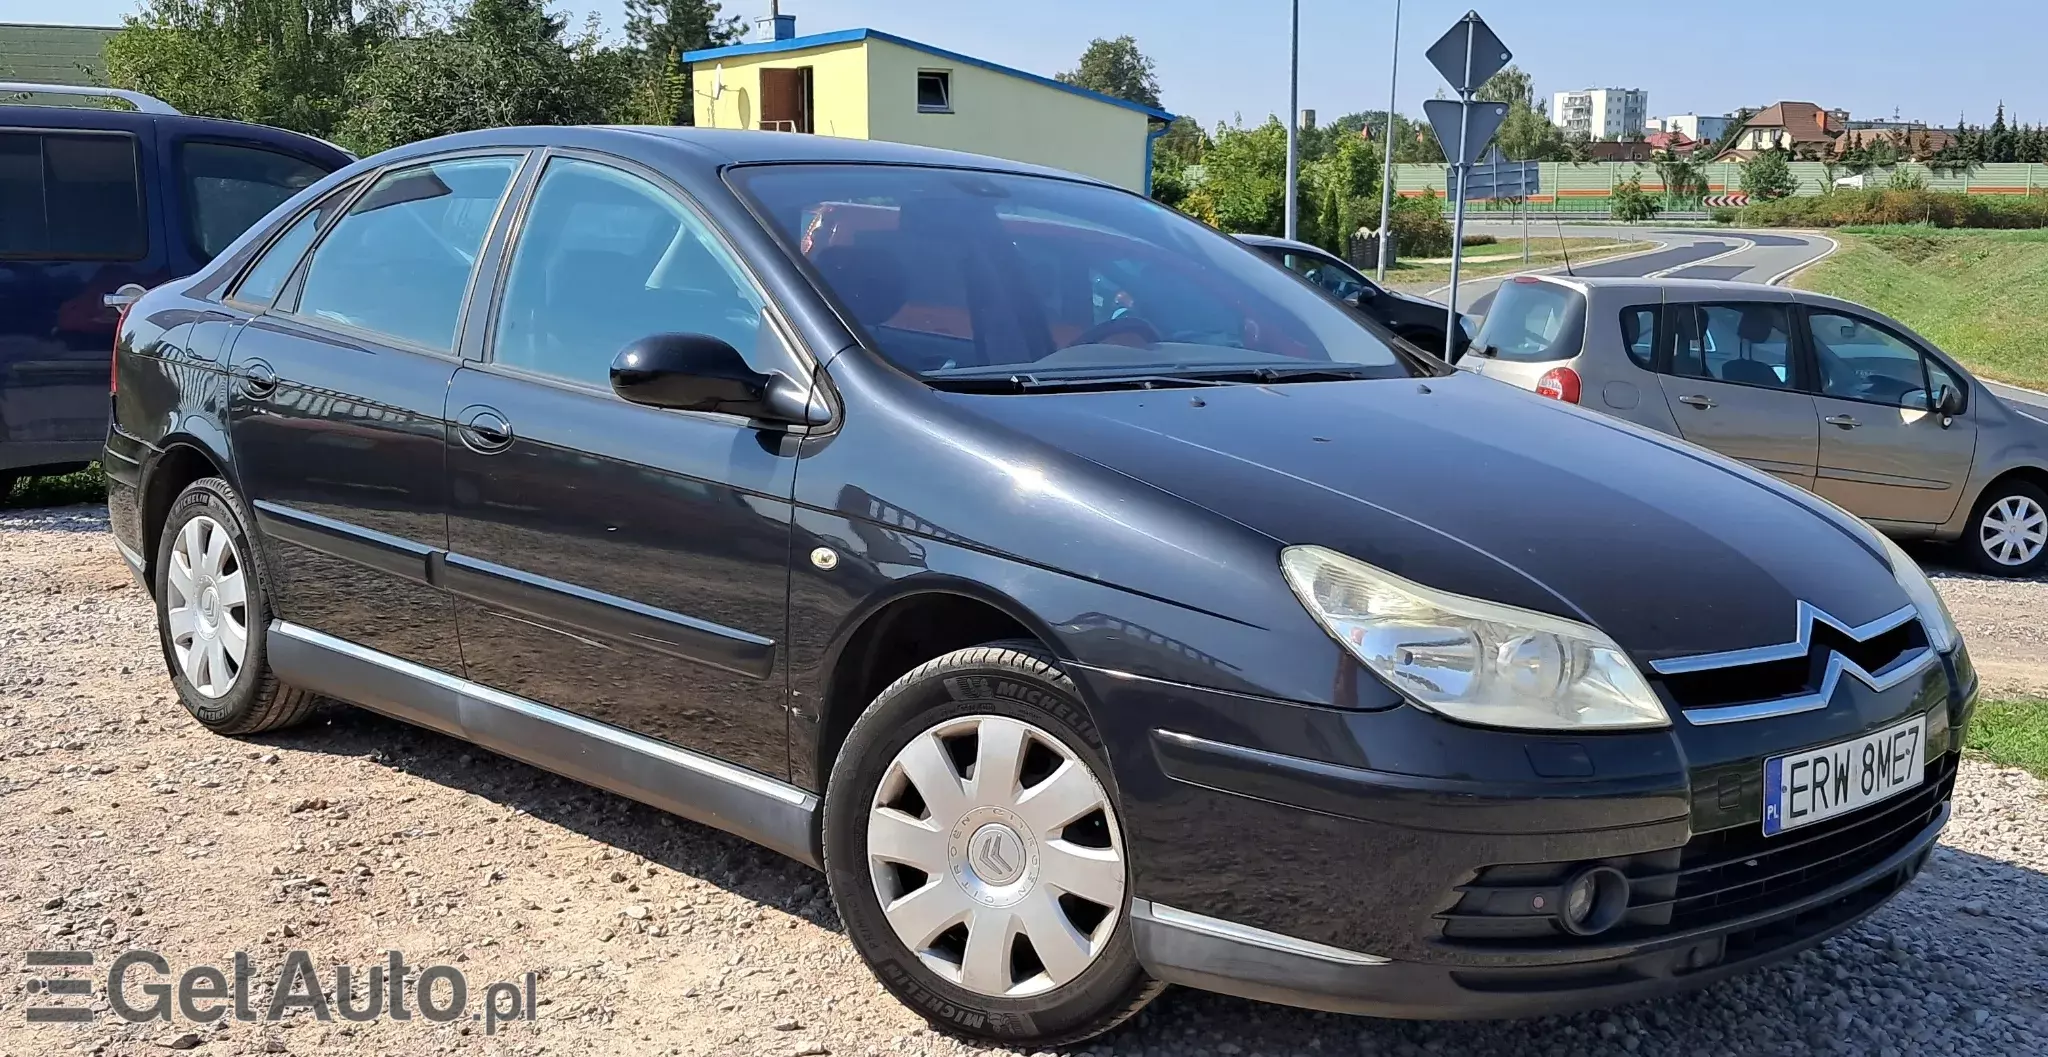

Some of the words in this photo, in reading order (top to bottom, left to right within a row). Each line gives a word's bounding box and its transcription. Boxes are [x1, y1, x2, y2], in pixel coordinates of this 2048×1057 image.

[996, 681, 1100, 744] MICHELIN
[1789, 749, 1850, 819] ERW
[1861, 725, 1919, 796] 8ME7
[1767, 804, 1779, 820] PL
[884, 964, 986, 1029] MICHELIN
